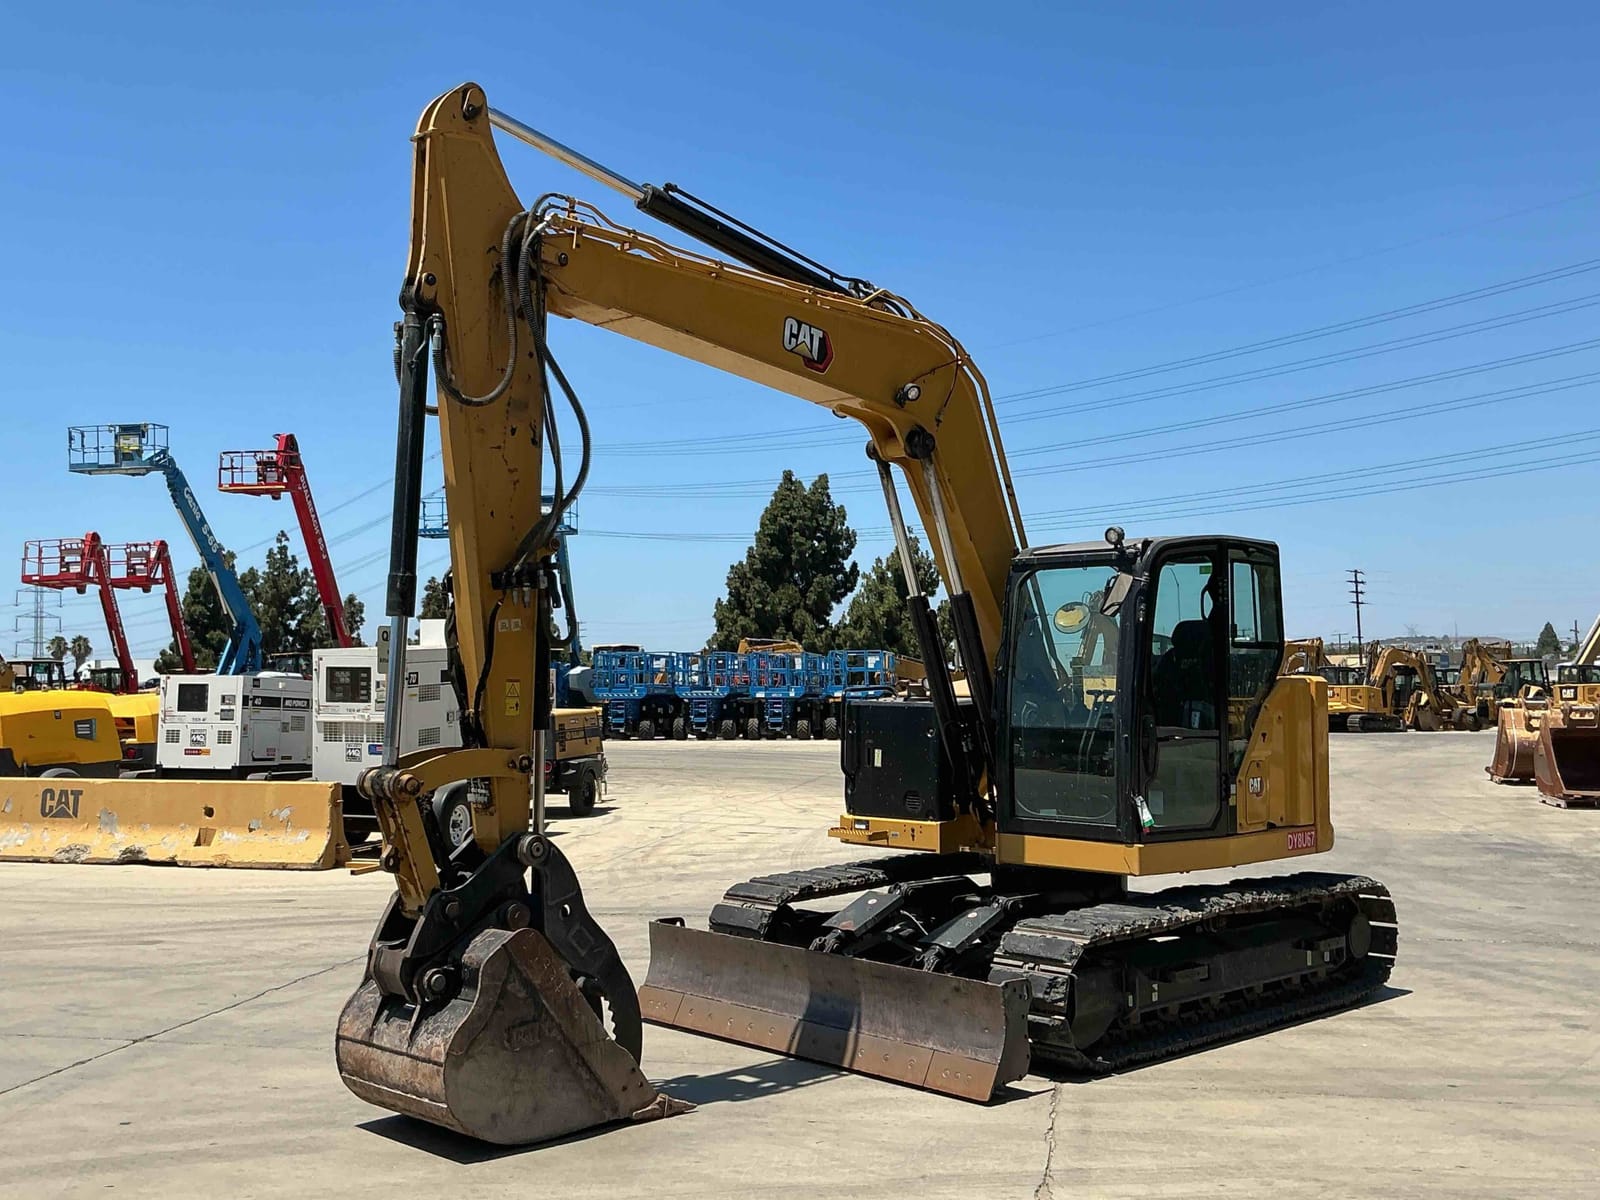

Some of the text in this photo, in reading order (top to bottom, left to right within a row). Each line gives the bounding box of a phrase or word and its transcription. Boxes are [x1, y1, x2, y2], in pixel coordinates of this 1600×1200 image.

[784, 318, 823, 361] CAT
[183, 486, 202, 521] Genie
[1562, 688, 1575, 699] CAT
[1249, 777, 1261, 793] CAT
[41, 788, 84, 819] CAT
[1287, 831, 1315, 850] DY8U67
